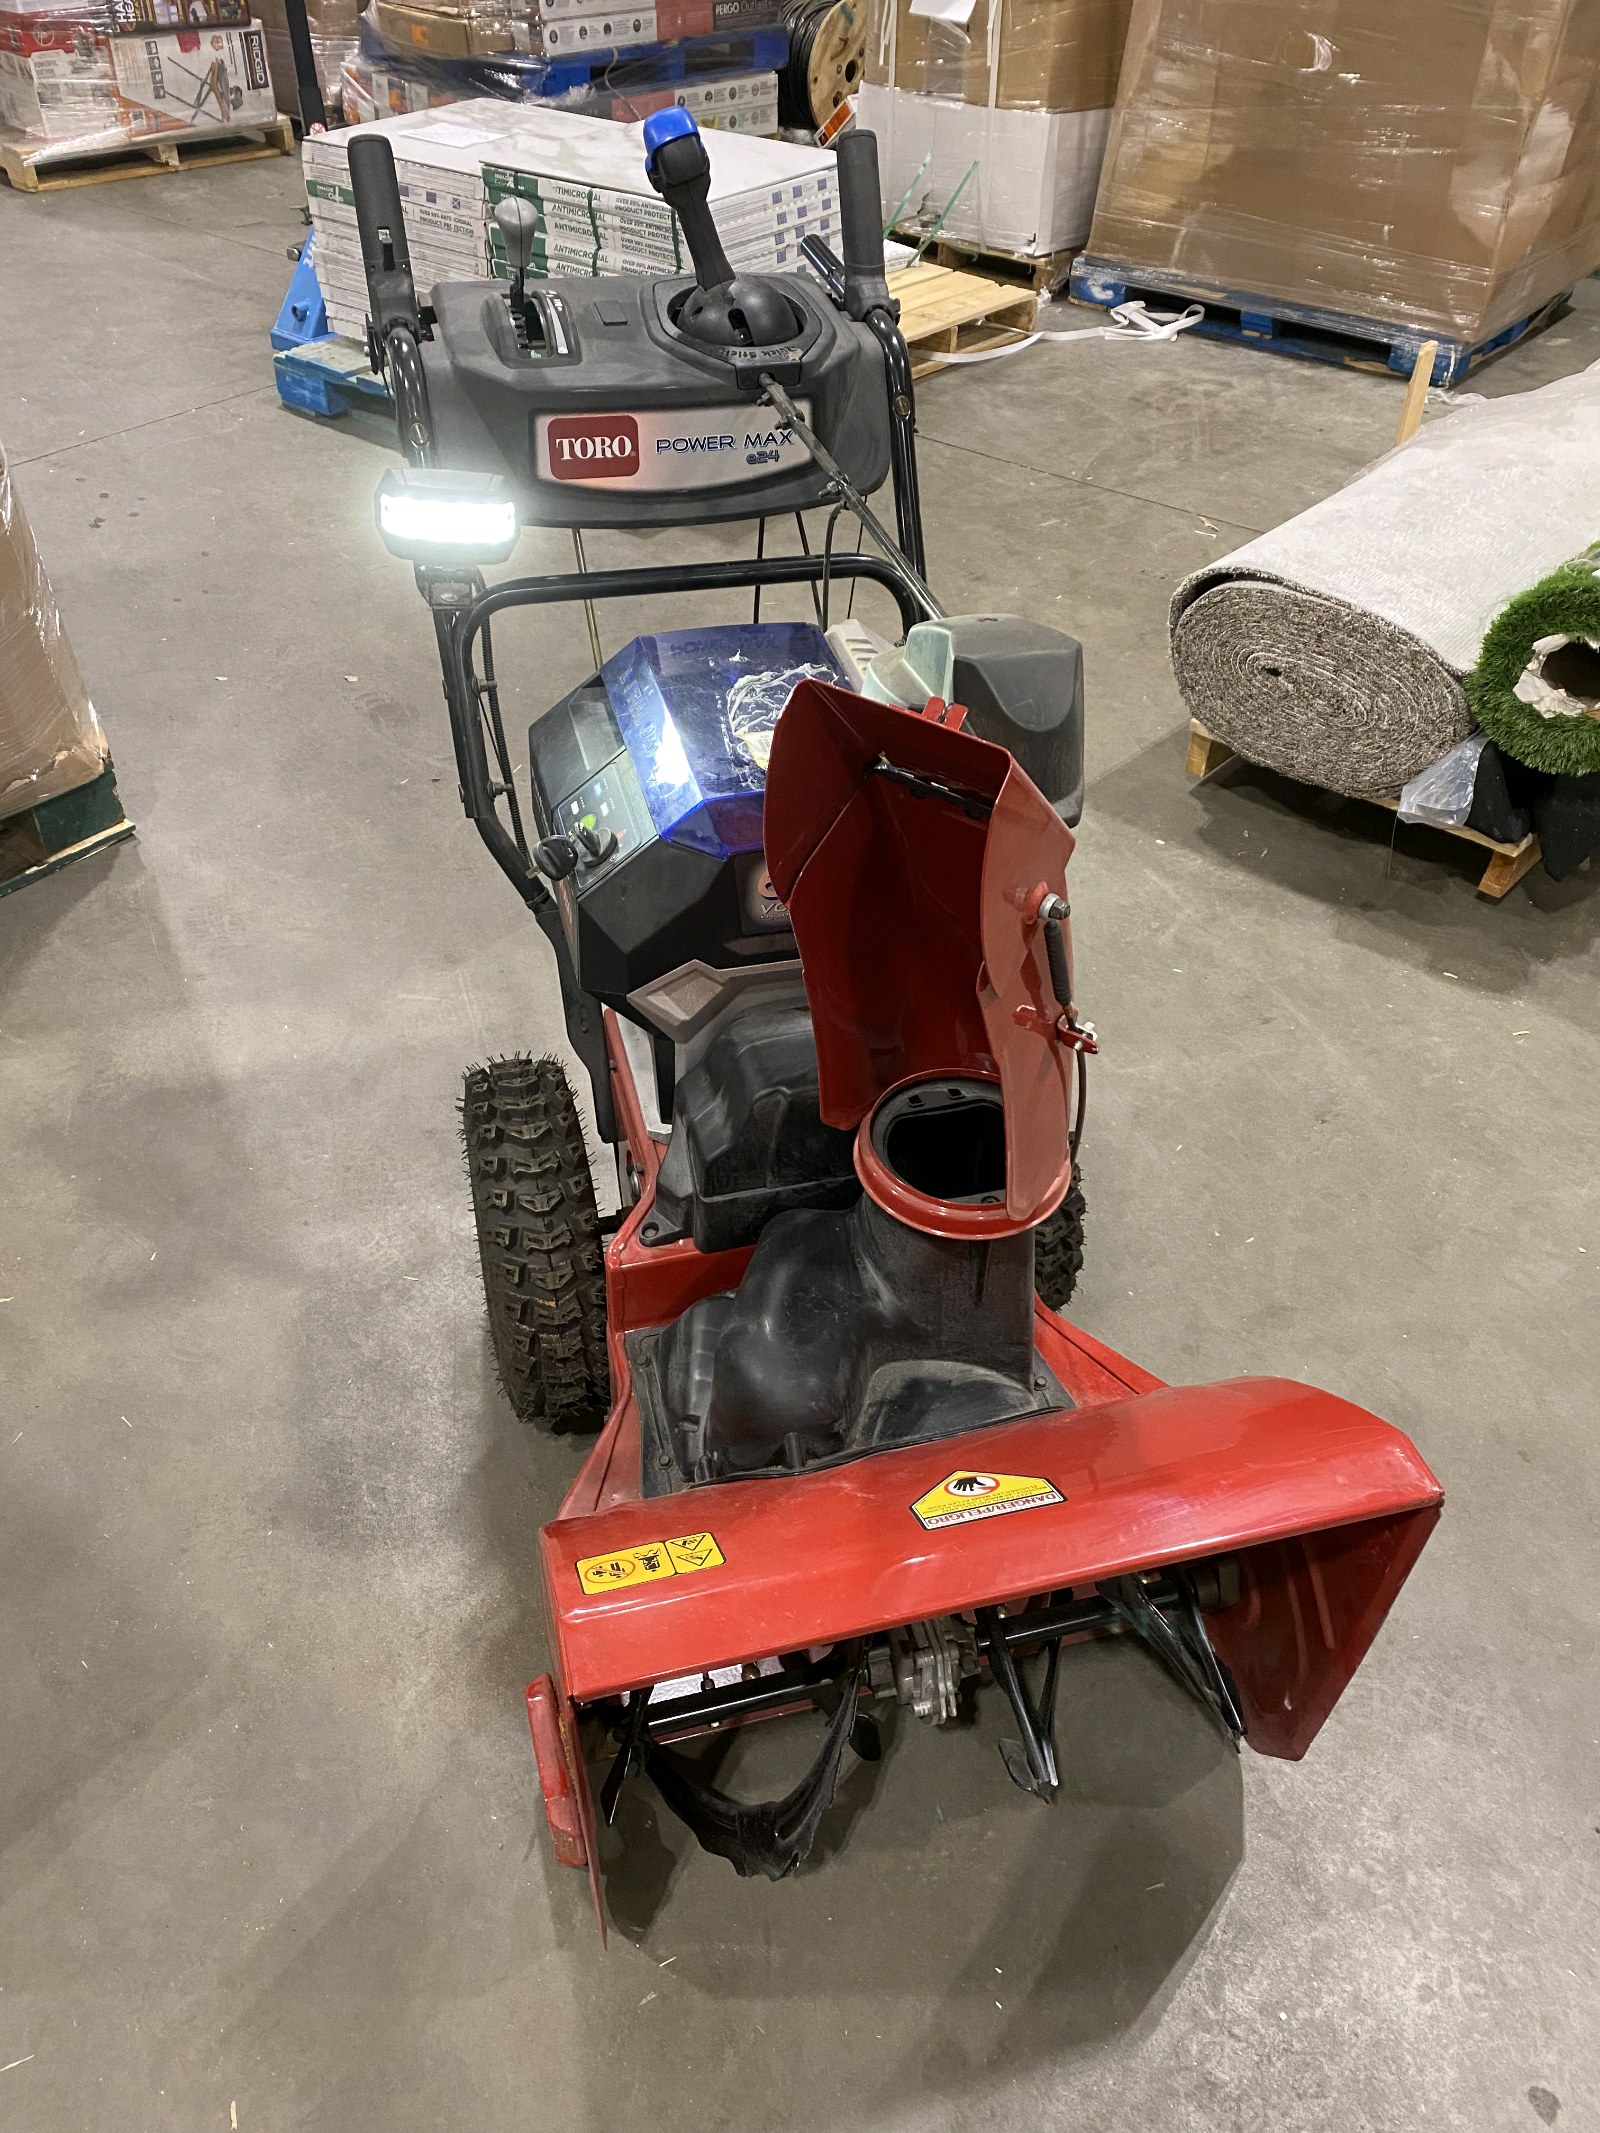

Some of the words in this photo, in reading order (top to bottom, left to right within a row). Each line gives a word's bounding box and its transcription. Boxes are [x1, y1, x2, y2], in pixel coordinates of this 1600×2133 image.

[715, 2, 740, 16] PERGO
[250, 34, 266, 84] RIDGID
[614, 205, 643, 215] PRODUCT
[621, 243, 648, 254] PRODUCT
[555, 435, 633, 461] TORO
[656, 434, 737, 454] POWER
[743, 429, 796, 449] MAX
[746, 451, 780, 465] e24
[927, 1492, 1057, 1525] DANGER/PELIGRO
